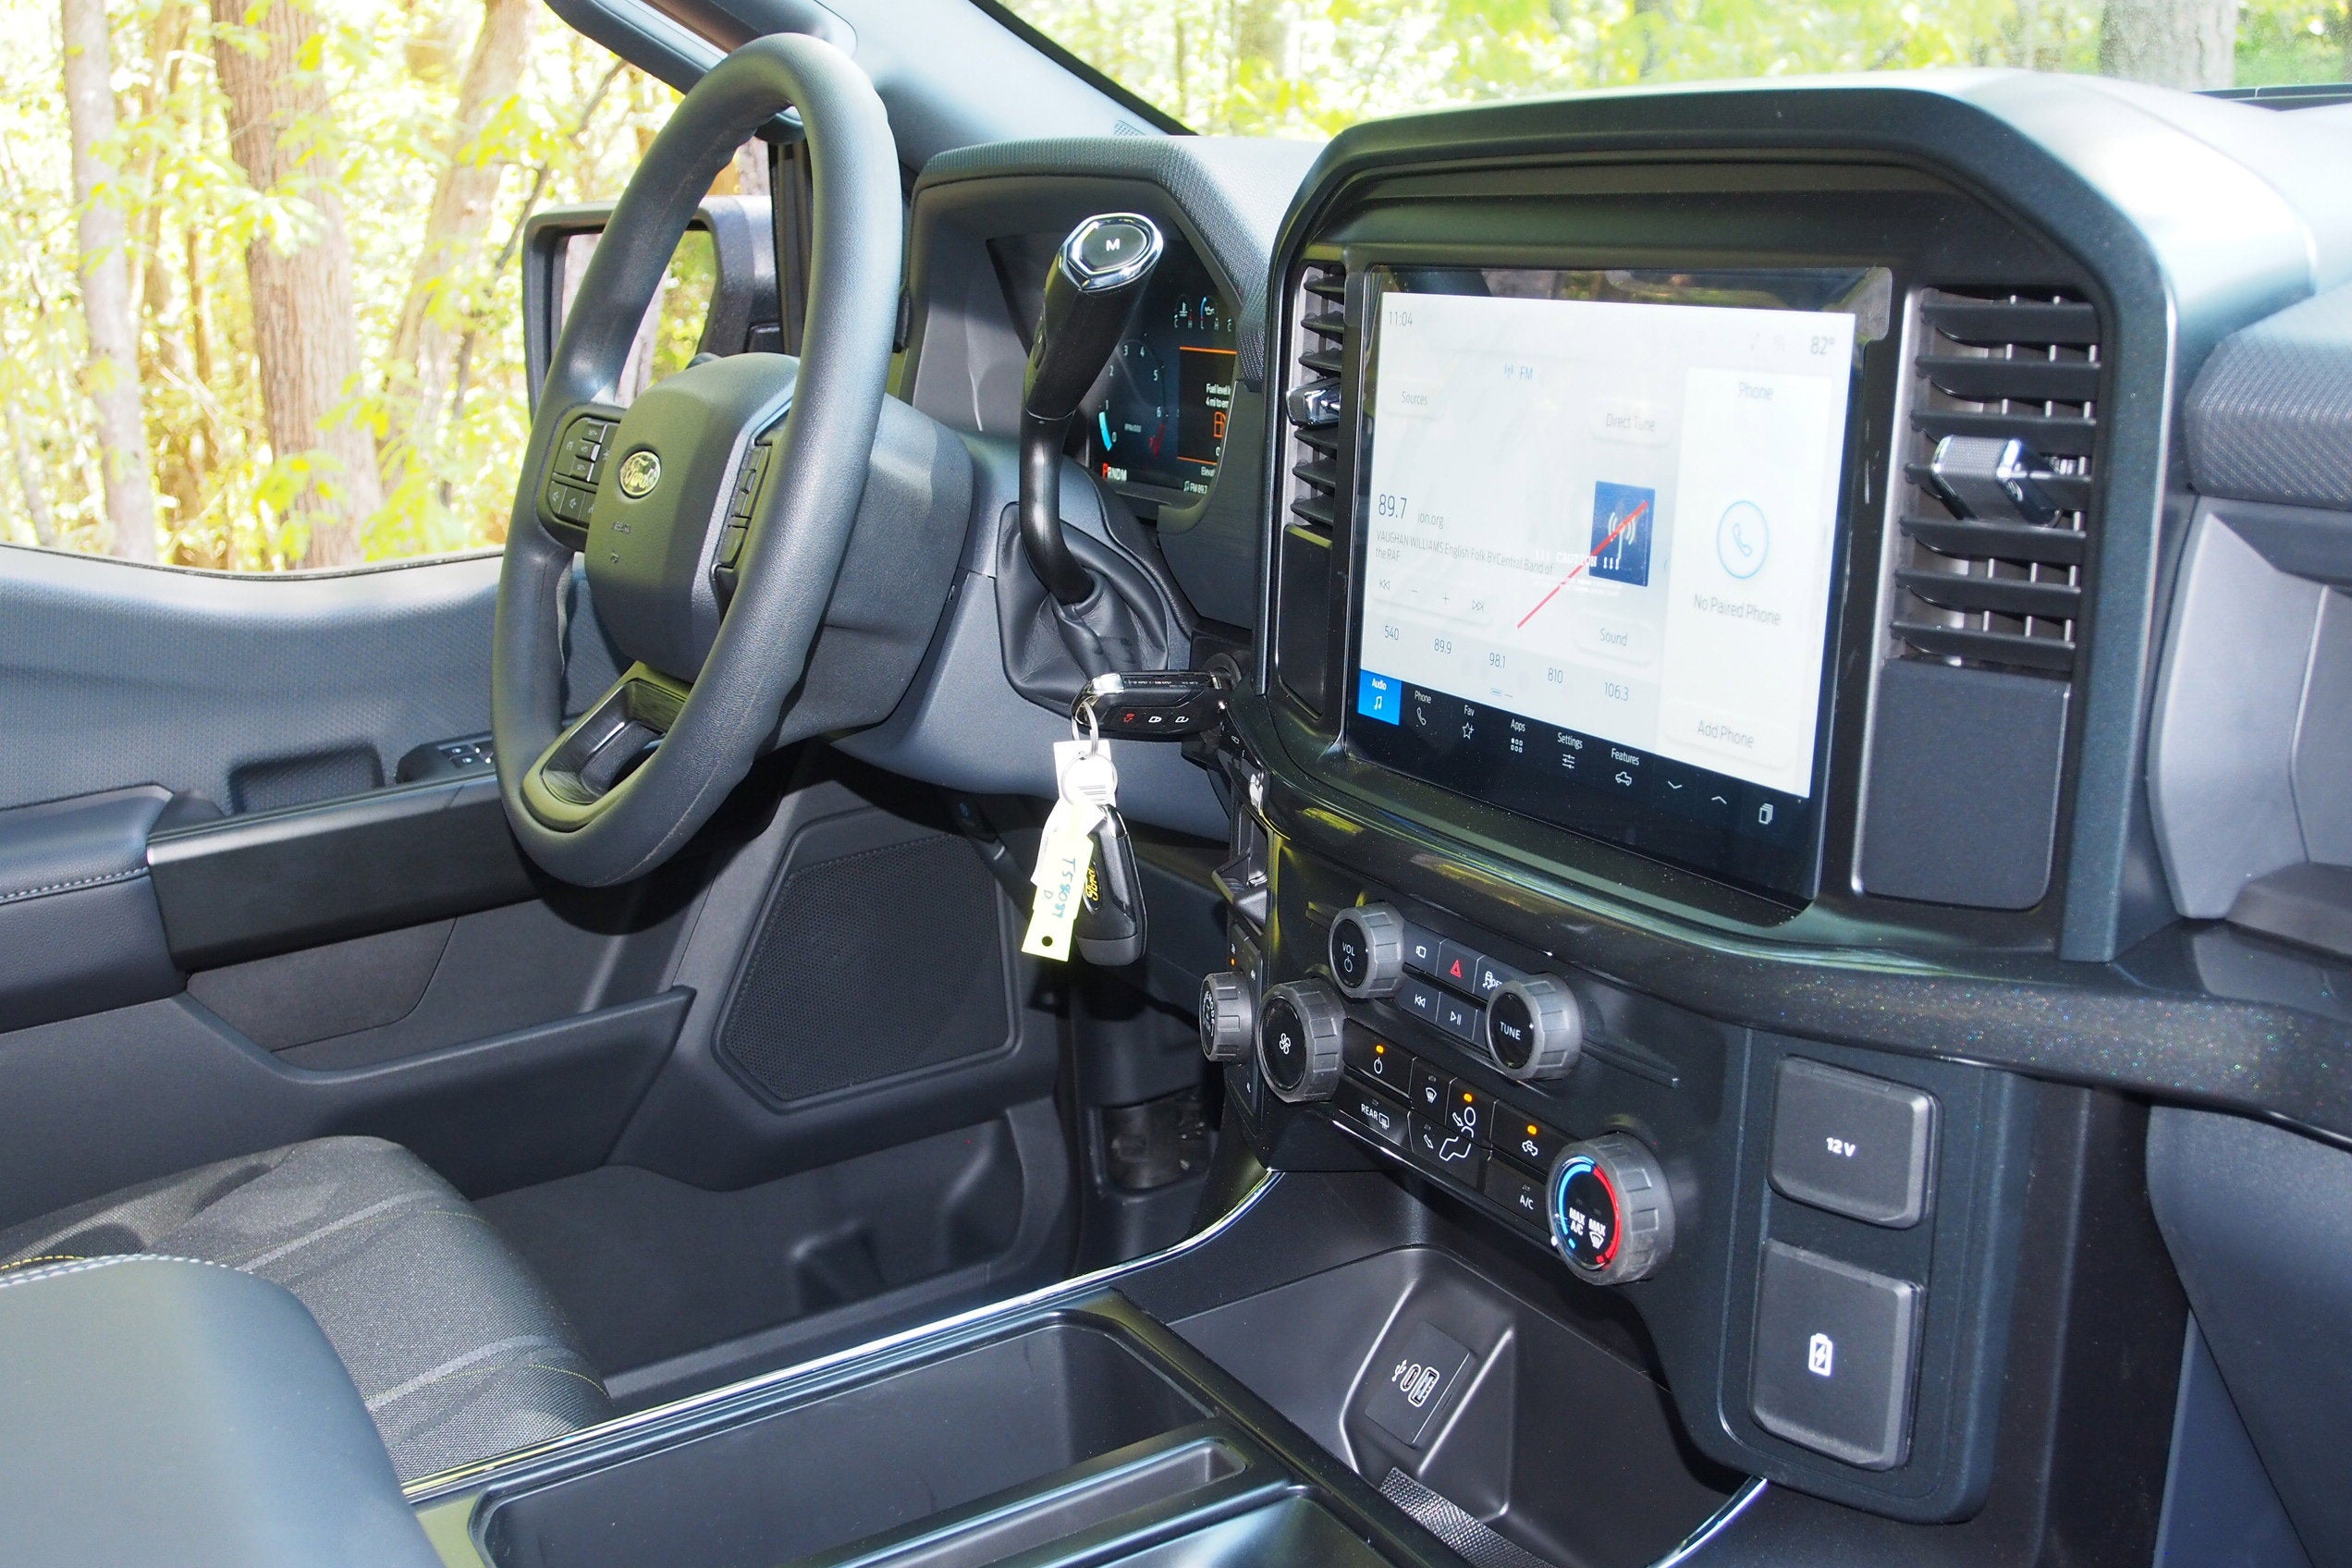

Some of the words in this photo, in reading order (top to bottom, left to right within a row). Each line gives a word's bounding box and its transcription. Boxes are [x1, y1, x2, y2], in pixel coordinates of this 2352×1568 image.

[1106, 239, 1121, 251] M
[1388, 312, 1413, 327] 11:04
[1809, 335, 1835, 355] 82°
[1520, 367, 1533, 381] FM
[1402, 391, 1427, 407] Sources
[1738, 381, 1774, 401] Phone
[1606, 413, 1630, 429] Direct
[1378, 493, 1407, 520] 89.7
[1377, 530, 1409, 546] VAUGHAN
[1410, 535, 1443, 554] WILLIAMS
[1444, 543, 1469, 560] English
[1470, 549, 1486, 561] Folk
[1524, 558, 1543, 574] Band
[1544, 563, 1554, 575] of
[1694, 594, 1709, 611] No
[1710, 596, 1744, 619] Paired
[1746, 603, 1781, 626] Phone
[1384, 625, 1400, 642] 540
[1599, 627, 1627, 647] Sound
[1433, 638, 1452, 655] 89.9
[1488, 652, 1507, 670] 98.1
[1371, 677, 1387, 692] Audio
[1548, 667, 1563, 685] 810
[1414, 690, 1432, 704] Phone
[1603, 681, 1630, 702] 106.3
[1464, 704, 1476, 717] Fav
[1510, 718, 1525, 733] Apps
[1697, 720, 1719, 740] Add
[1720, 725, 1754, 749] Phone
[1557, 731, 1583, 750] Settings
[1611, 748, 1640, 766] Features
[1341, 941, 1356, 959] VOL
[1500, 1021, 1522, 1041] TUNE
[1361, 1103, 1378, 1121] REAR
[1519, 1194, 1534, 1210] A/C
[1569, 1207, 1586, 1226] MAX
[1570, 1219, 1584, 1236] A/C
[1588, 1218, 1606, 1237] MAX
